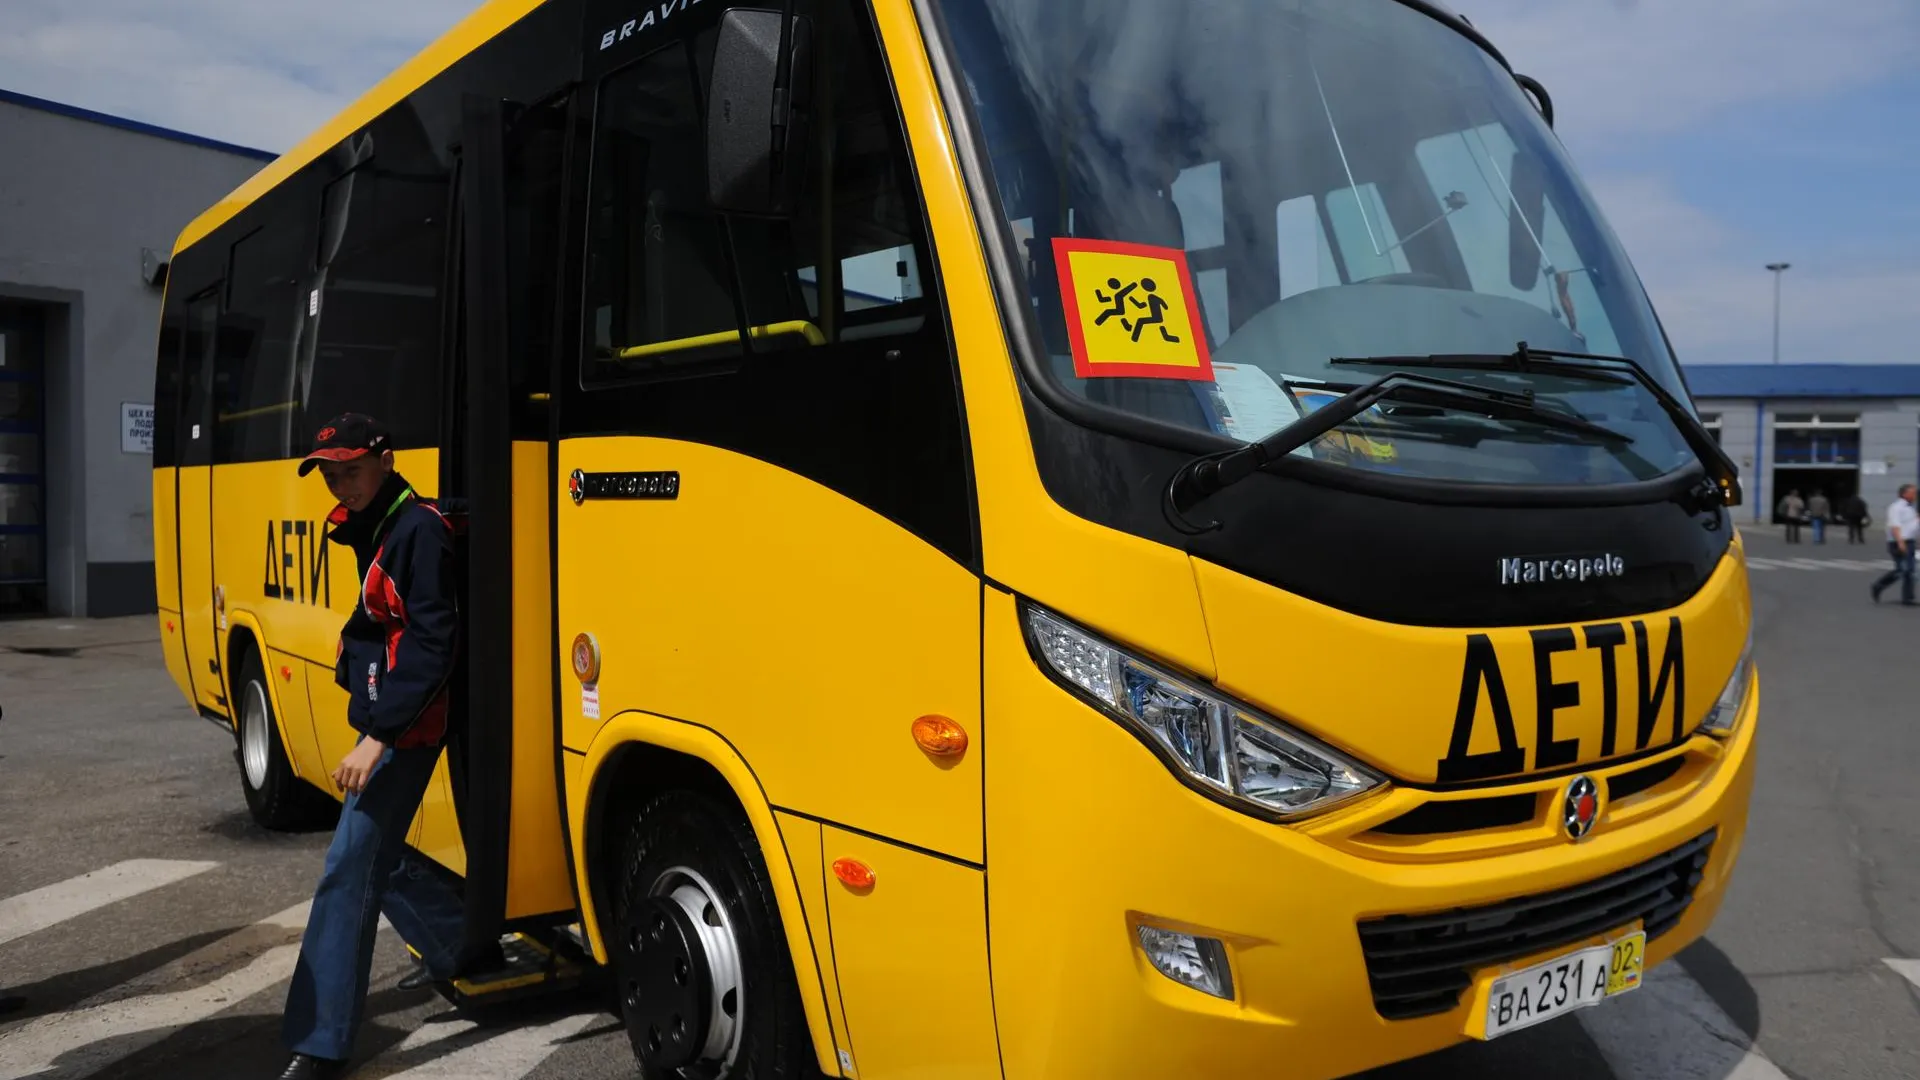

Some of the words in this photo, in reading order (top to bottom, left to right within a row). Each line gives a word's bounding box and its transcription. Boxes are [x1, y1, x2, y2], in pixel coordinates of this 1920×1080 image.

[600, 0, 702, 51] BRAVI
[264, 520, 330, 609] ДЕТИ
[1501, 553, 1625, 586] Marcopolo
[1436, 616, 1685, 783] ДЕТИ
[1611, 942, 1634, 974] 02
